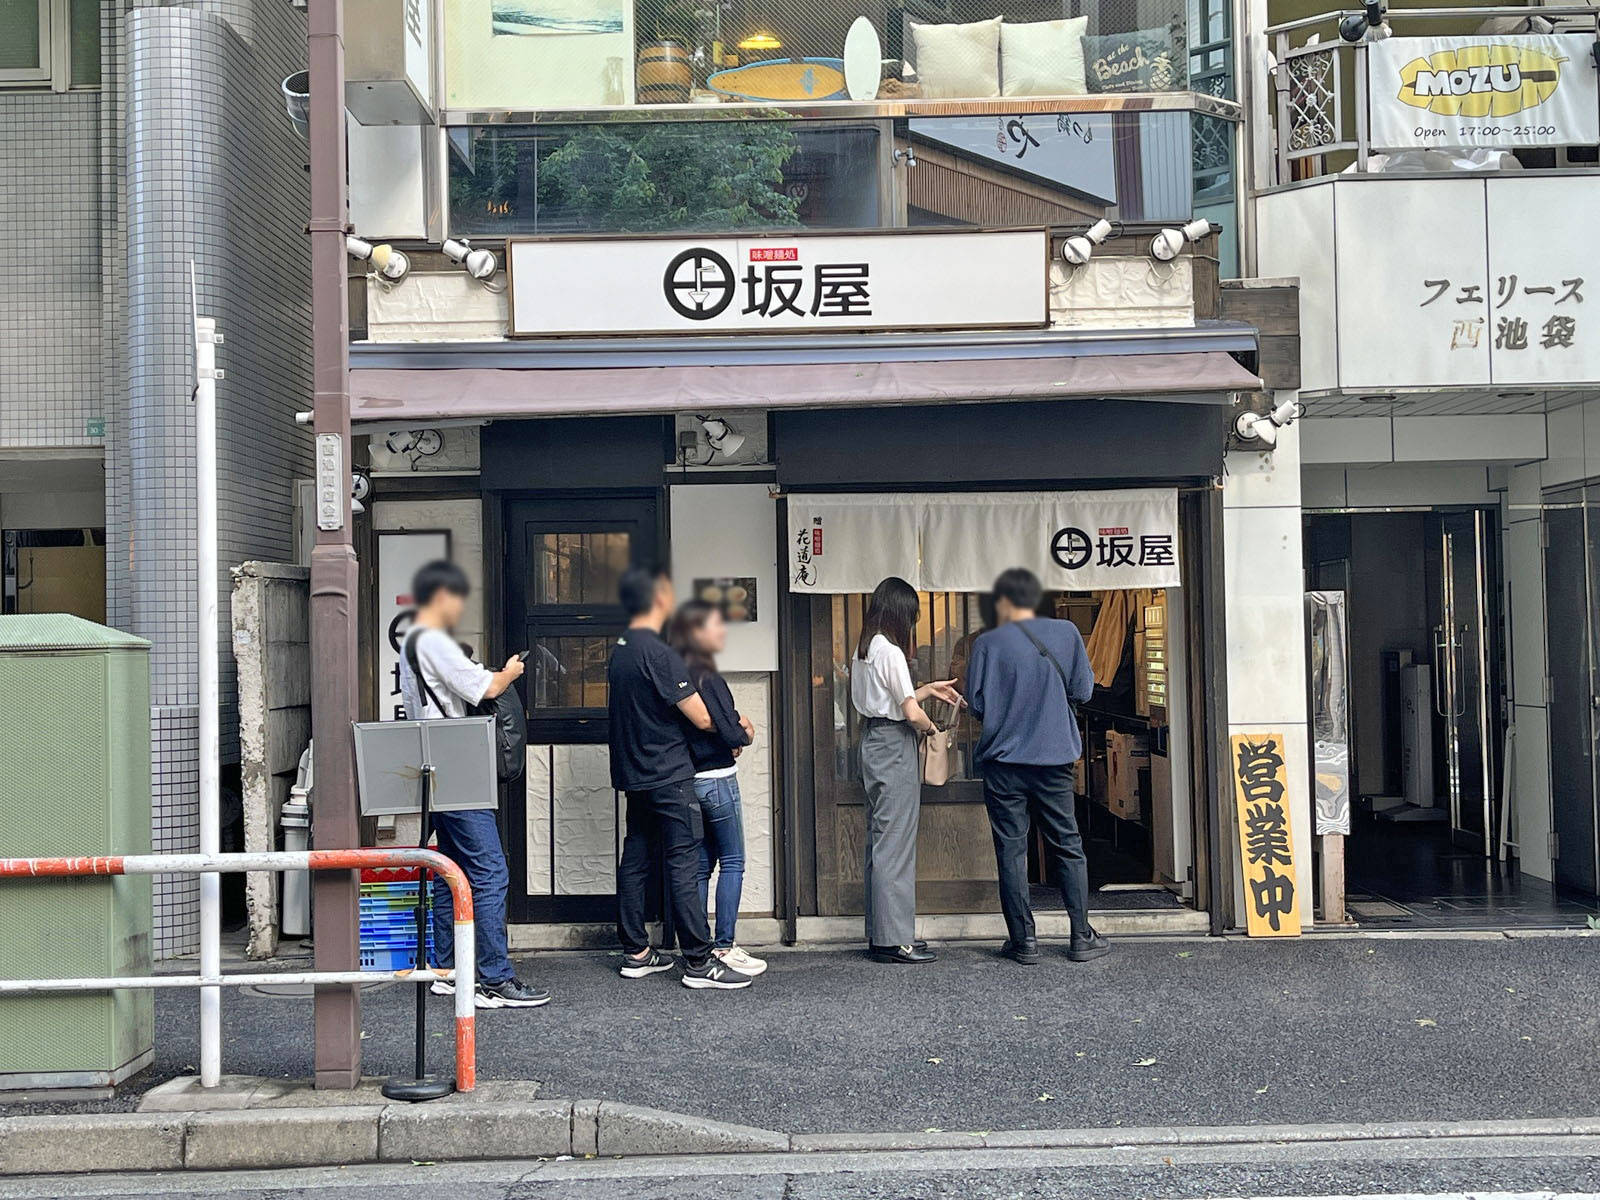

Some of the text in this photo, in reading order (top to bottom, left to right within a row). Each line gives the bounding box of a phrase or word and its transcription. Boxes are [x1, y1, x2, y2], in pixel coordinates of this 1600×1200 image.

[1092, 46, 1150, 81] Beach
[1414, 63, 1522, 97] MOZU
[1414, 126, 1447, 139] Open
[741, 263, 873, 318] 坂屋
[1420, 274, 1585, 310] フェリース
[1450, 314, 1577, 351] 西池袋
[1095, 535, 1175, 568] 坂屋
[1237, 740, 1296, 932] 営業中
